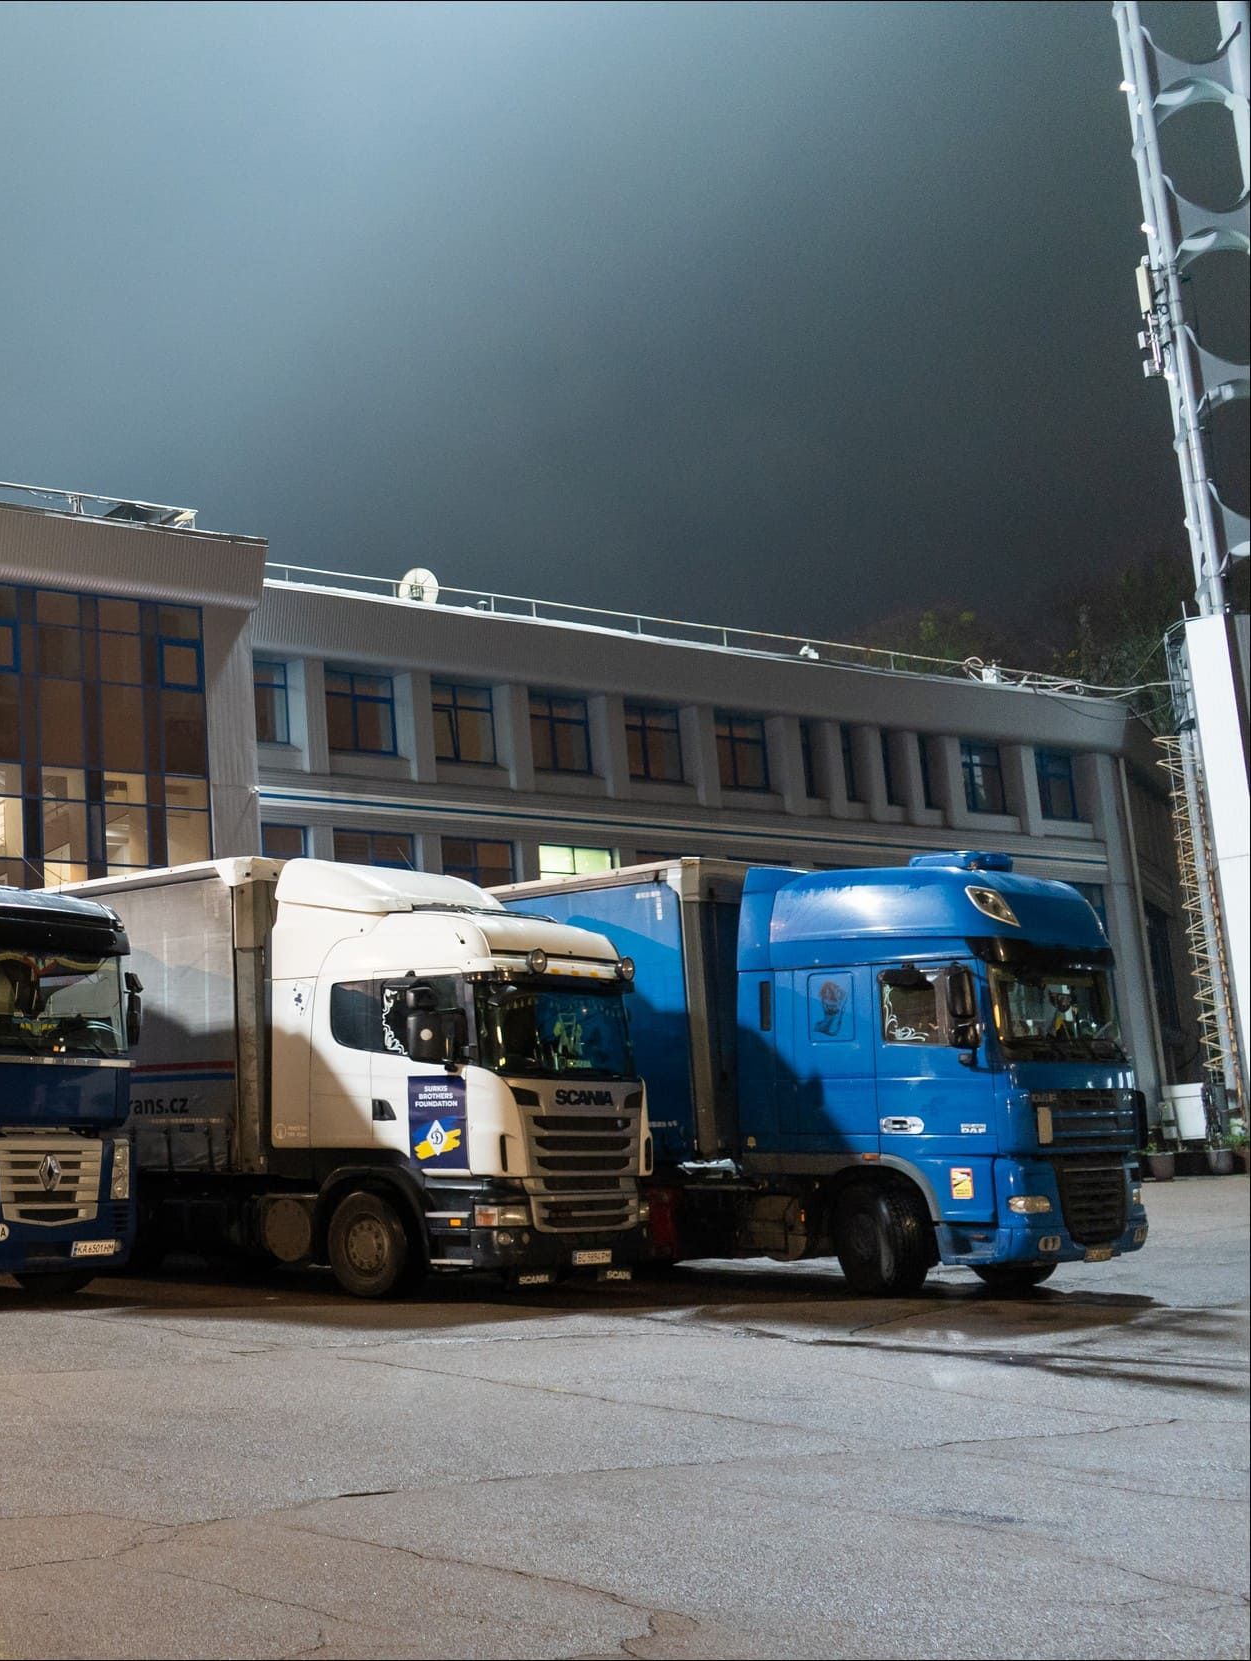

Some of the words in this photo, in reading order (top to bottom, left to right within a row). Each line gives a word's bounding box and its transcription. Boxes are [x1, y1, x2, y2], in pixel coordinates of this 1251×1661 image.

[418, 1092, 454, 1100] BROTHERS
[555, 1088, 614, 1106] SCANIA
[414, 1100, 459, 1108] FOUNDATION
